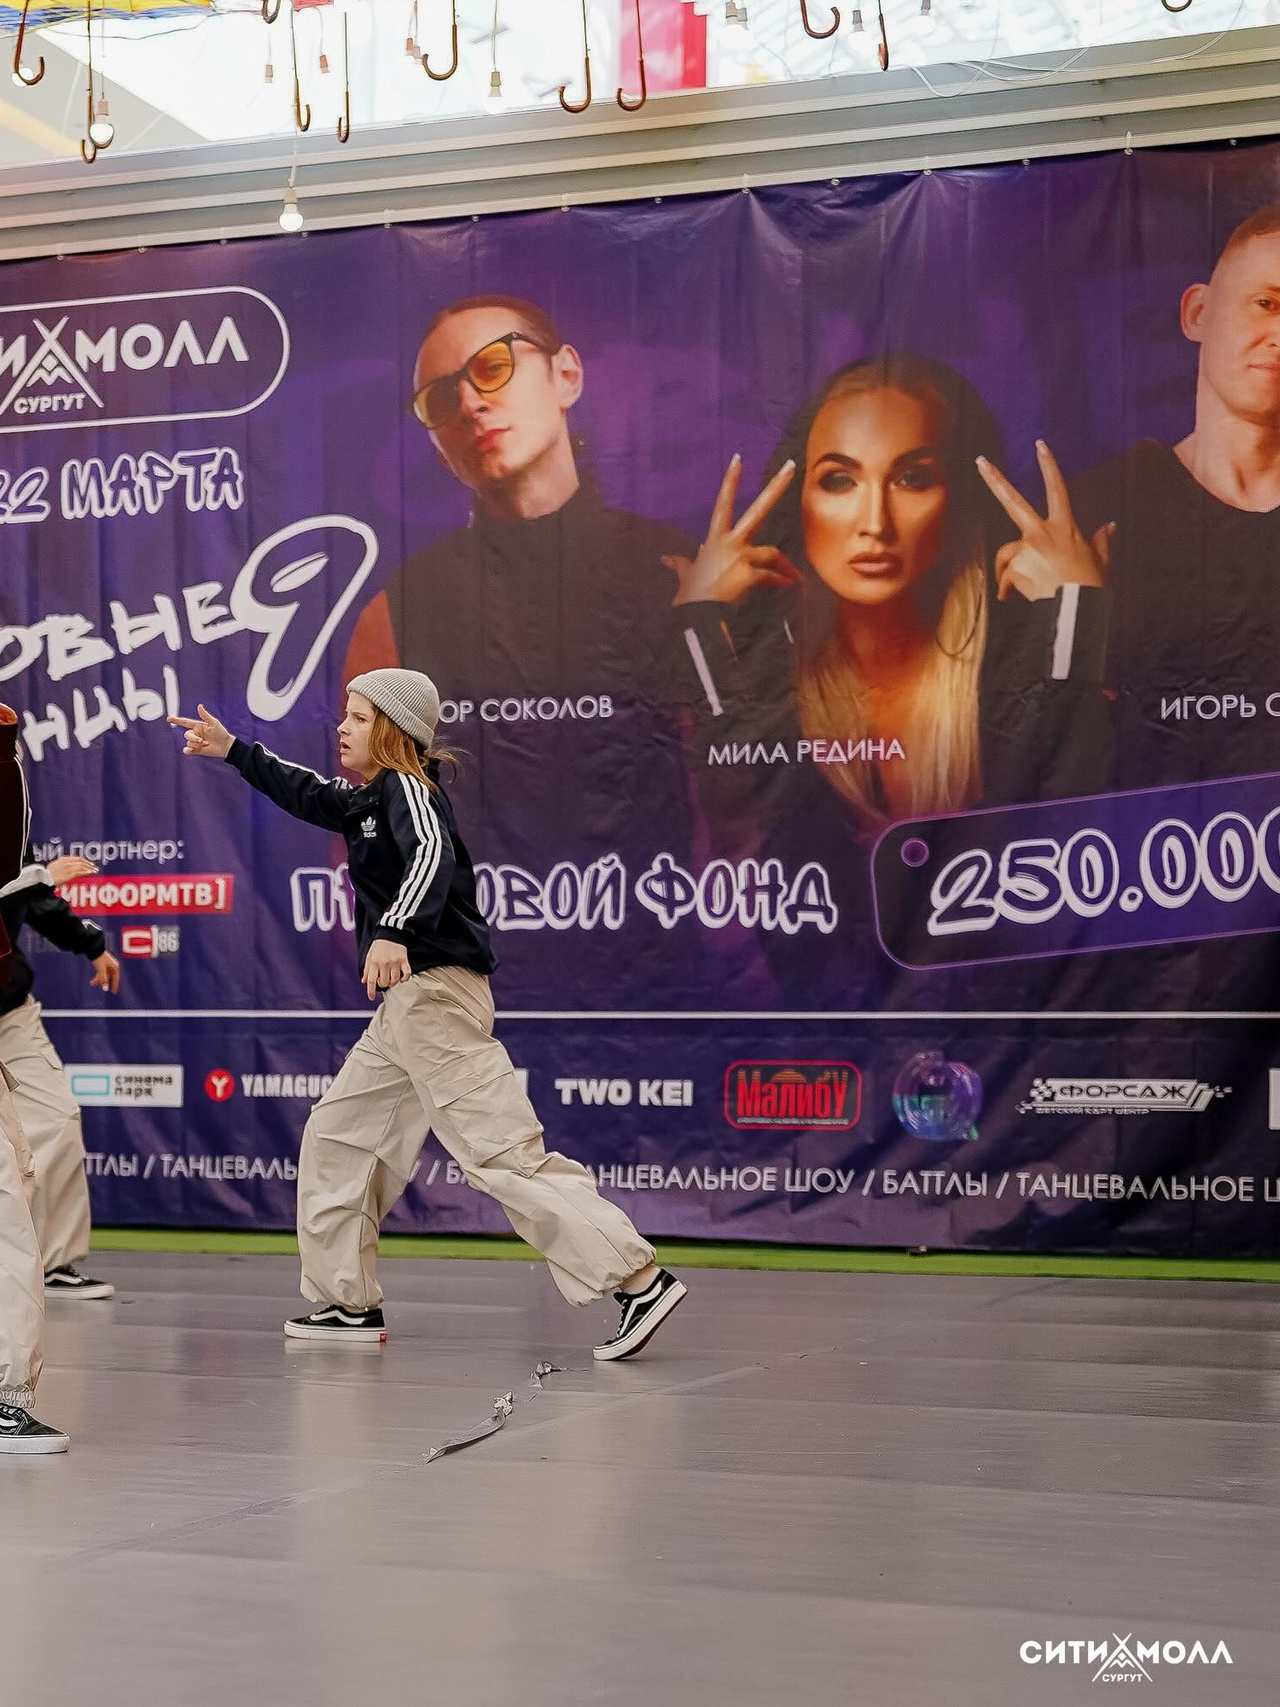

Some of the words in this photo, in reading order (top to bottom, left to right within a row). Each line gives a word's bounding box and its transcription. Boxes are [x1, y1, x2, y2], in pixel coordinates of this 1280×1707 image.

[74, 315, 251, 373] МОЛЛ
[13, 392, 86, 415] СУРГУТ
[60, 446, 244, 520] МАРТА
[479, 694, 614, 722] СОКОЛОВ
[1160, 694, 1257, 720] ИГОРЬ
[707, 741, 790, 766] МИЛА
[796, 737, 906, 765] РЕДИНА
[70, 839, 185, 866] партнер:
[635, 852, 839, 935] ФОНД
[554, 1078, 632, 1106] TWO
[638, 1079, 694, 1107] KEI
[1059, 1085, 1188, 1100] ФОРСАЖ
[159, 1153, 297, 1181] ТАНЦЕВАЛЬ
[785, 1167, 855, 1194] ШОУ
[883, 1170, 988, 1197] БАТТЛЫ
[1017, 1171, 1255, 1202] ТАНЦЕВАЛЬНОЕ
